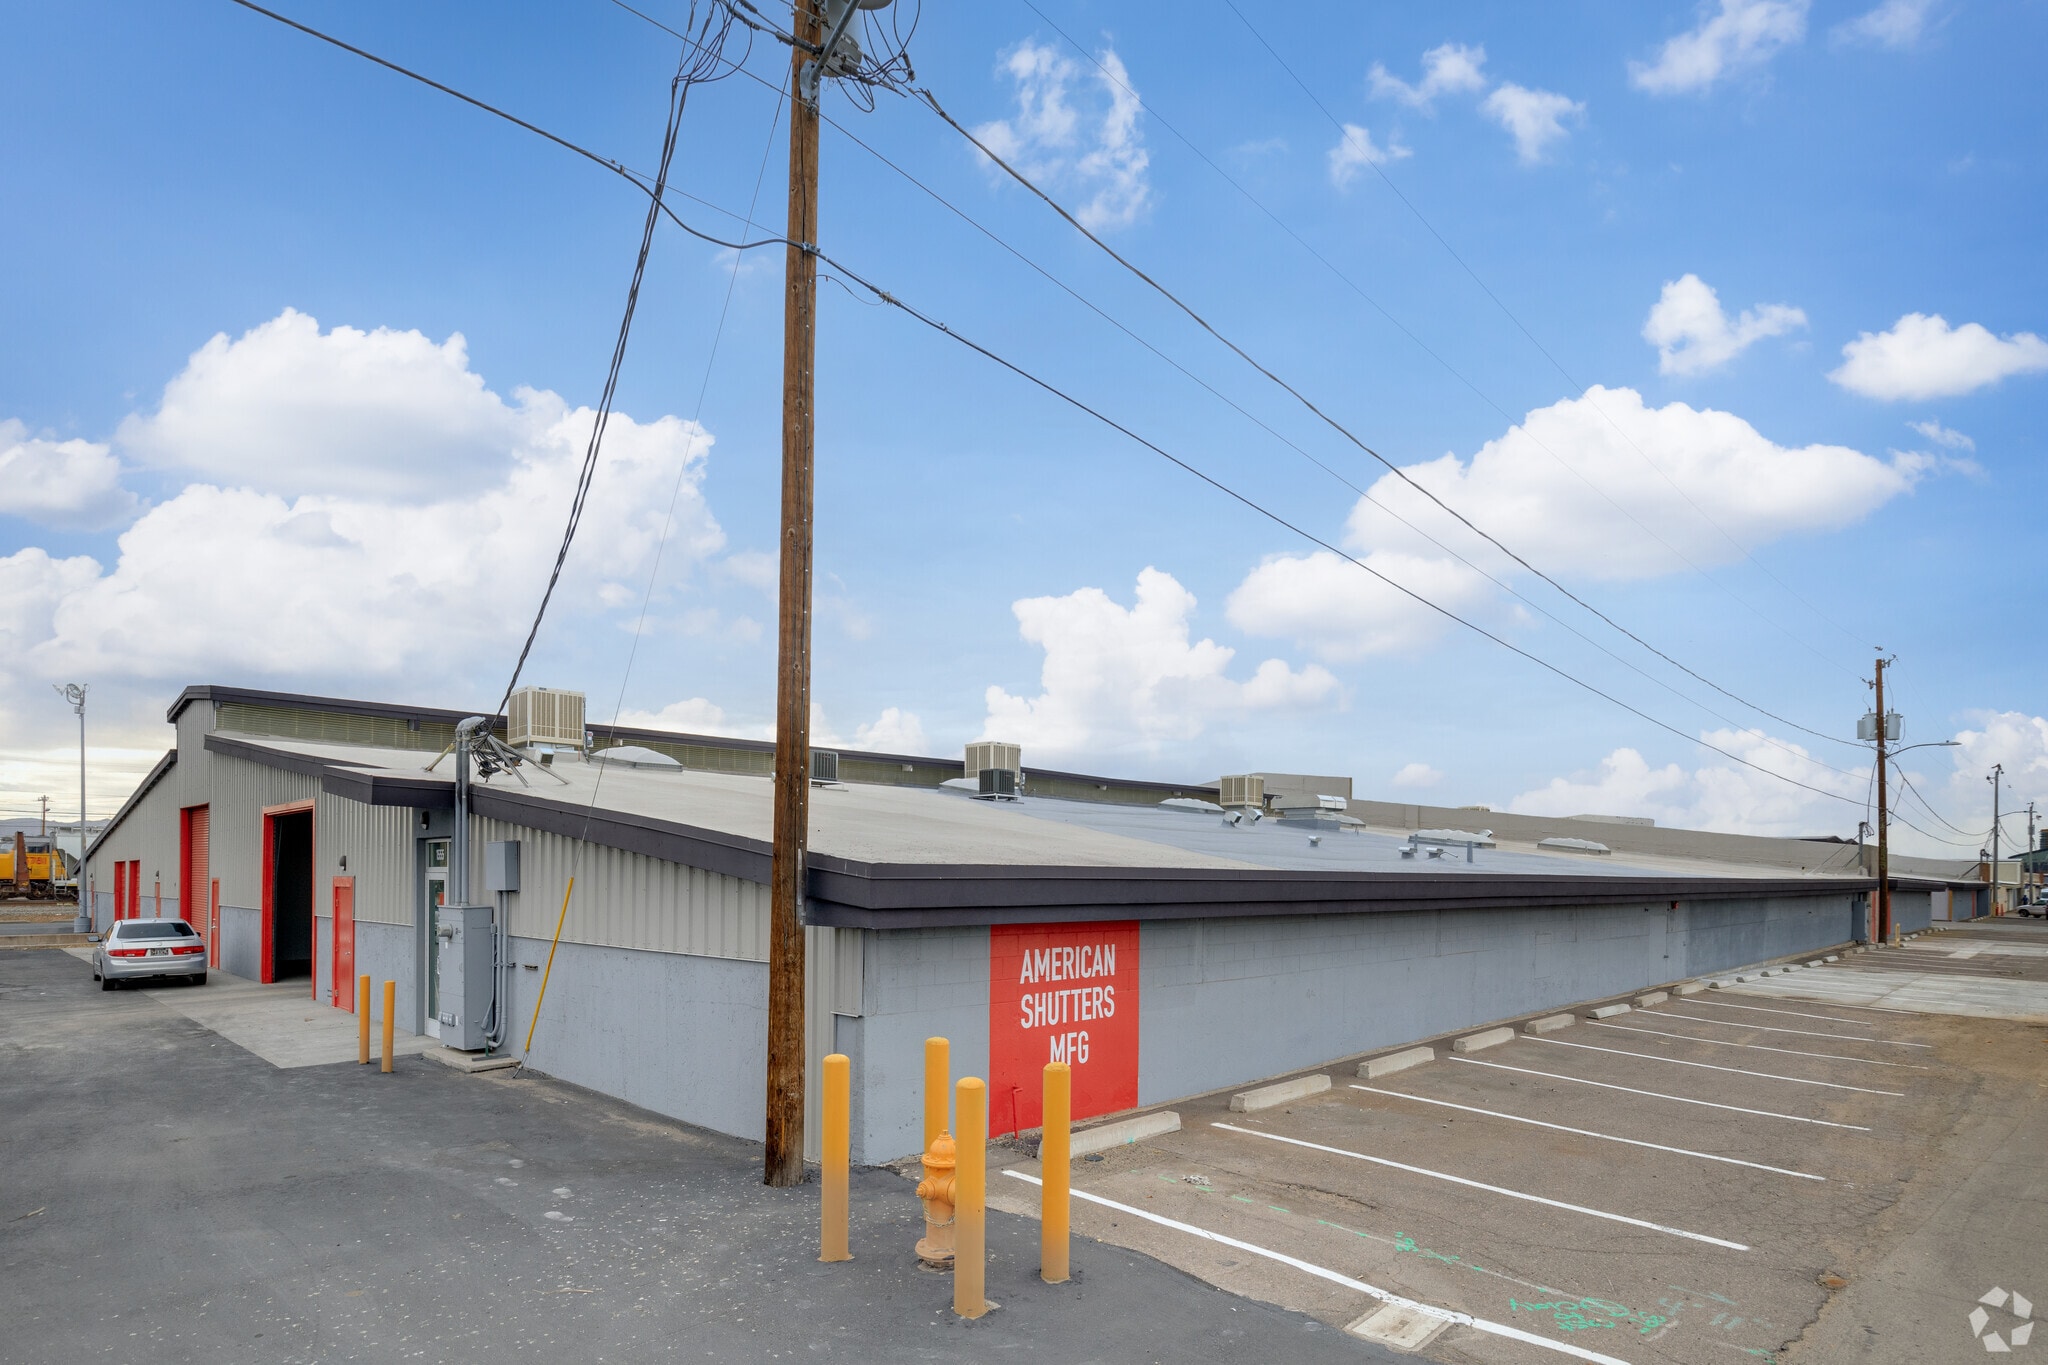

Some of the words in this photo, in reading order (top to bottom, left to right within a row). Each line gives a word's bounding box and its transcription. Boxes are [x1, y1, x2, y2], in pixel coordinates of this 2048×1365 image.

[1020, 944, 1115, 984] AMERICAN
[1020, 985, 1115, 1029] SHUTTERS
[1050, 1030, 1089, 1066] MFG
